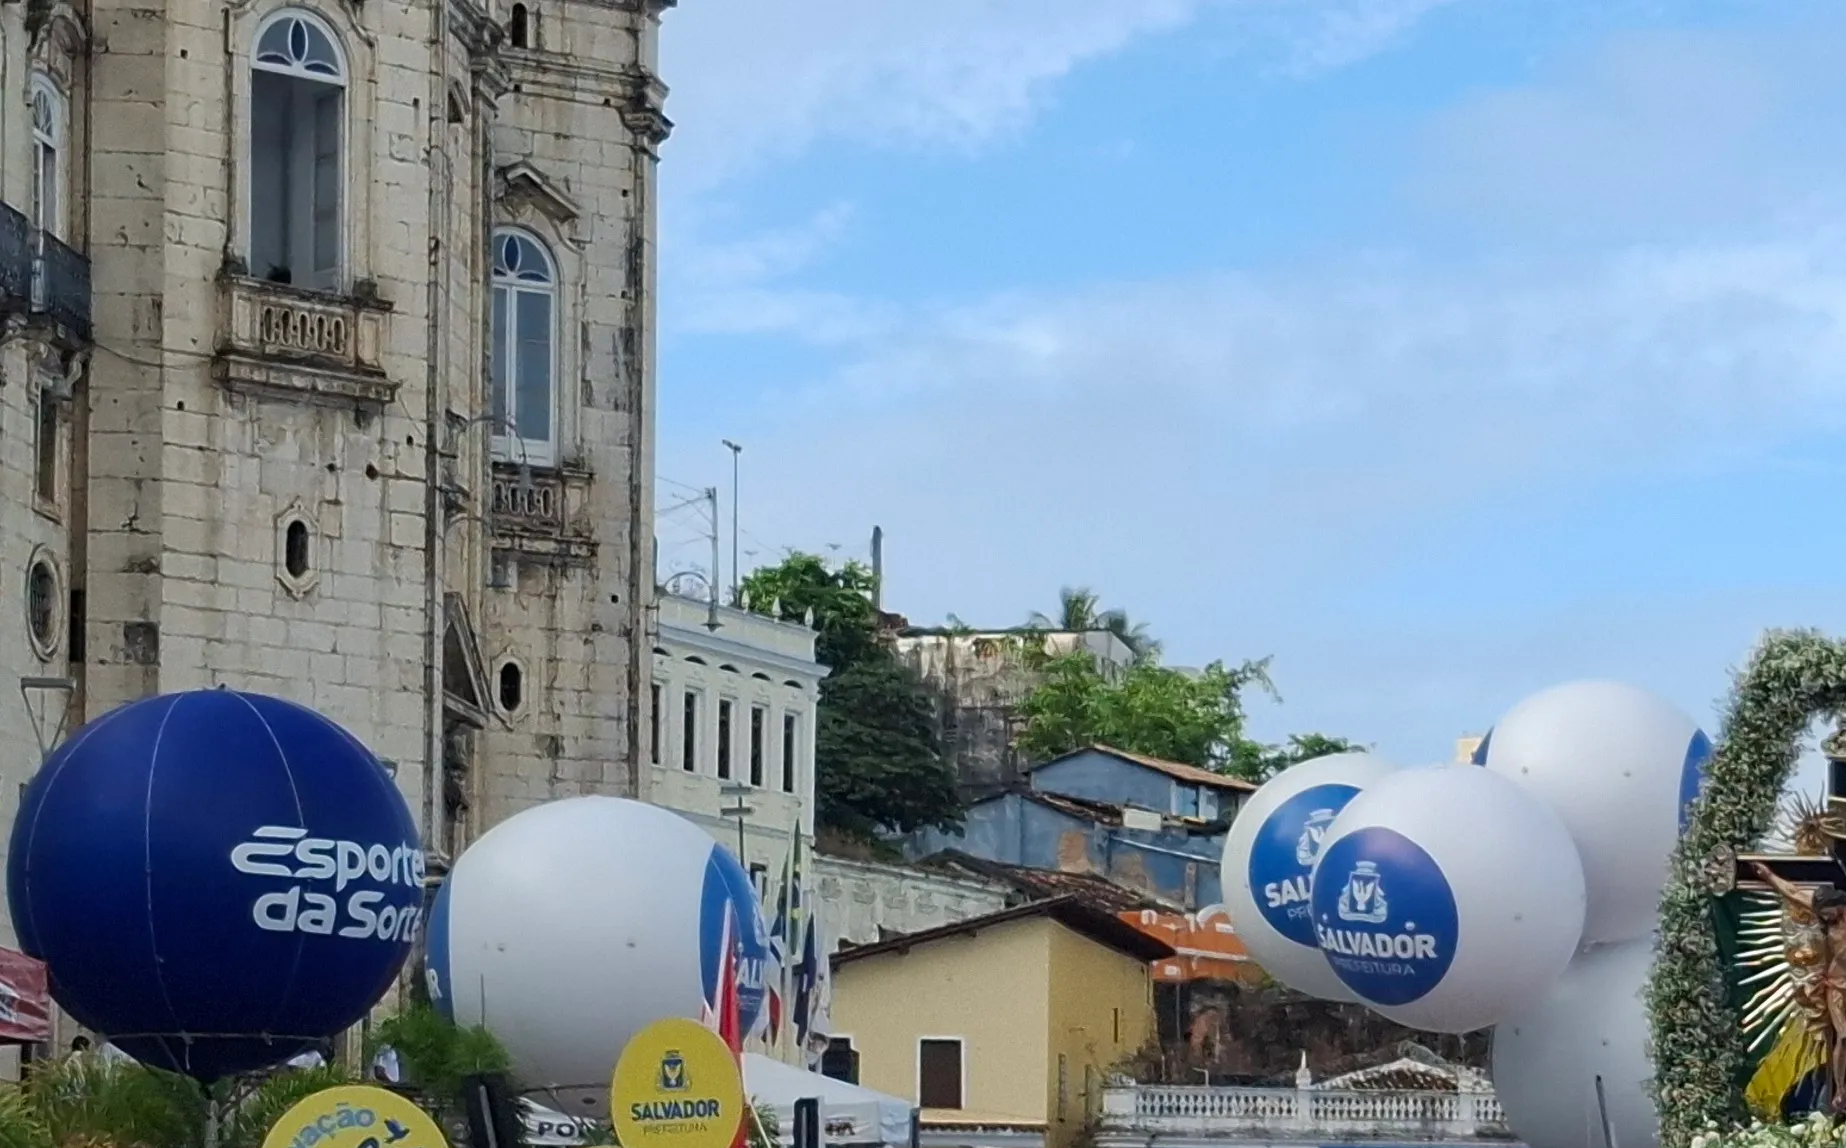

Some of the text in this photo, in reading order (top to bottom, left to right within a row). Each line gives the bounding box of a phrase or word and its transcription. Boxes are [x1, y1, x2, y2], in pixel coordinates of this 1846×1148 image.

[1265, 876, 1312, 908] SAL
[253, 885, 337, 935] da
[1317, 921, 1438, 960] SALVADOR
[630, 1099, 720, 1122] SALVADOR
